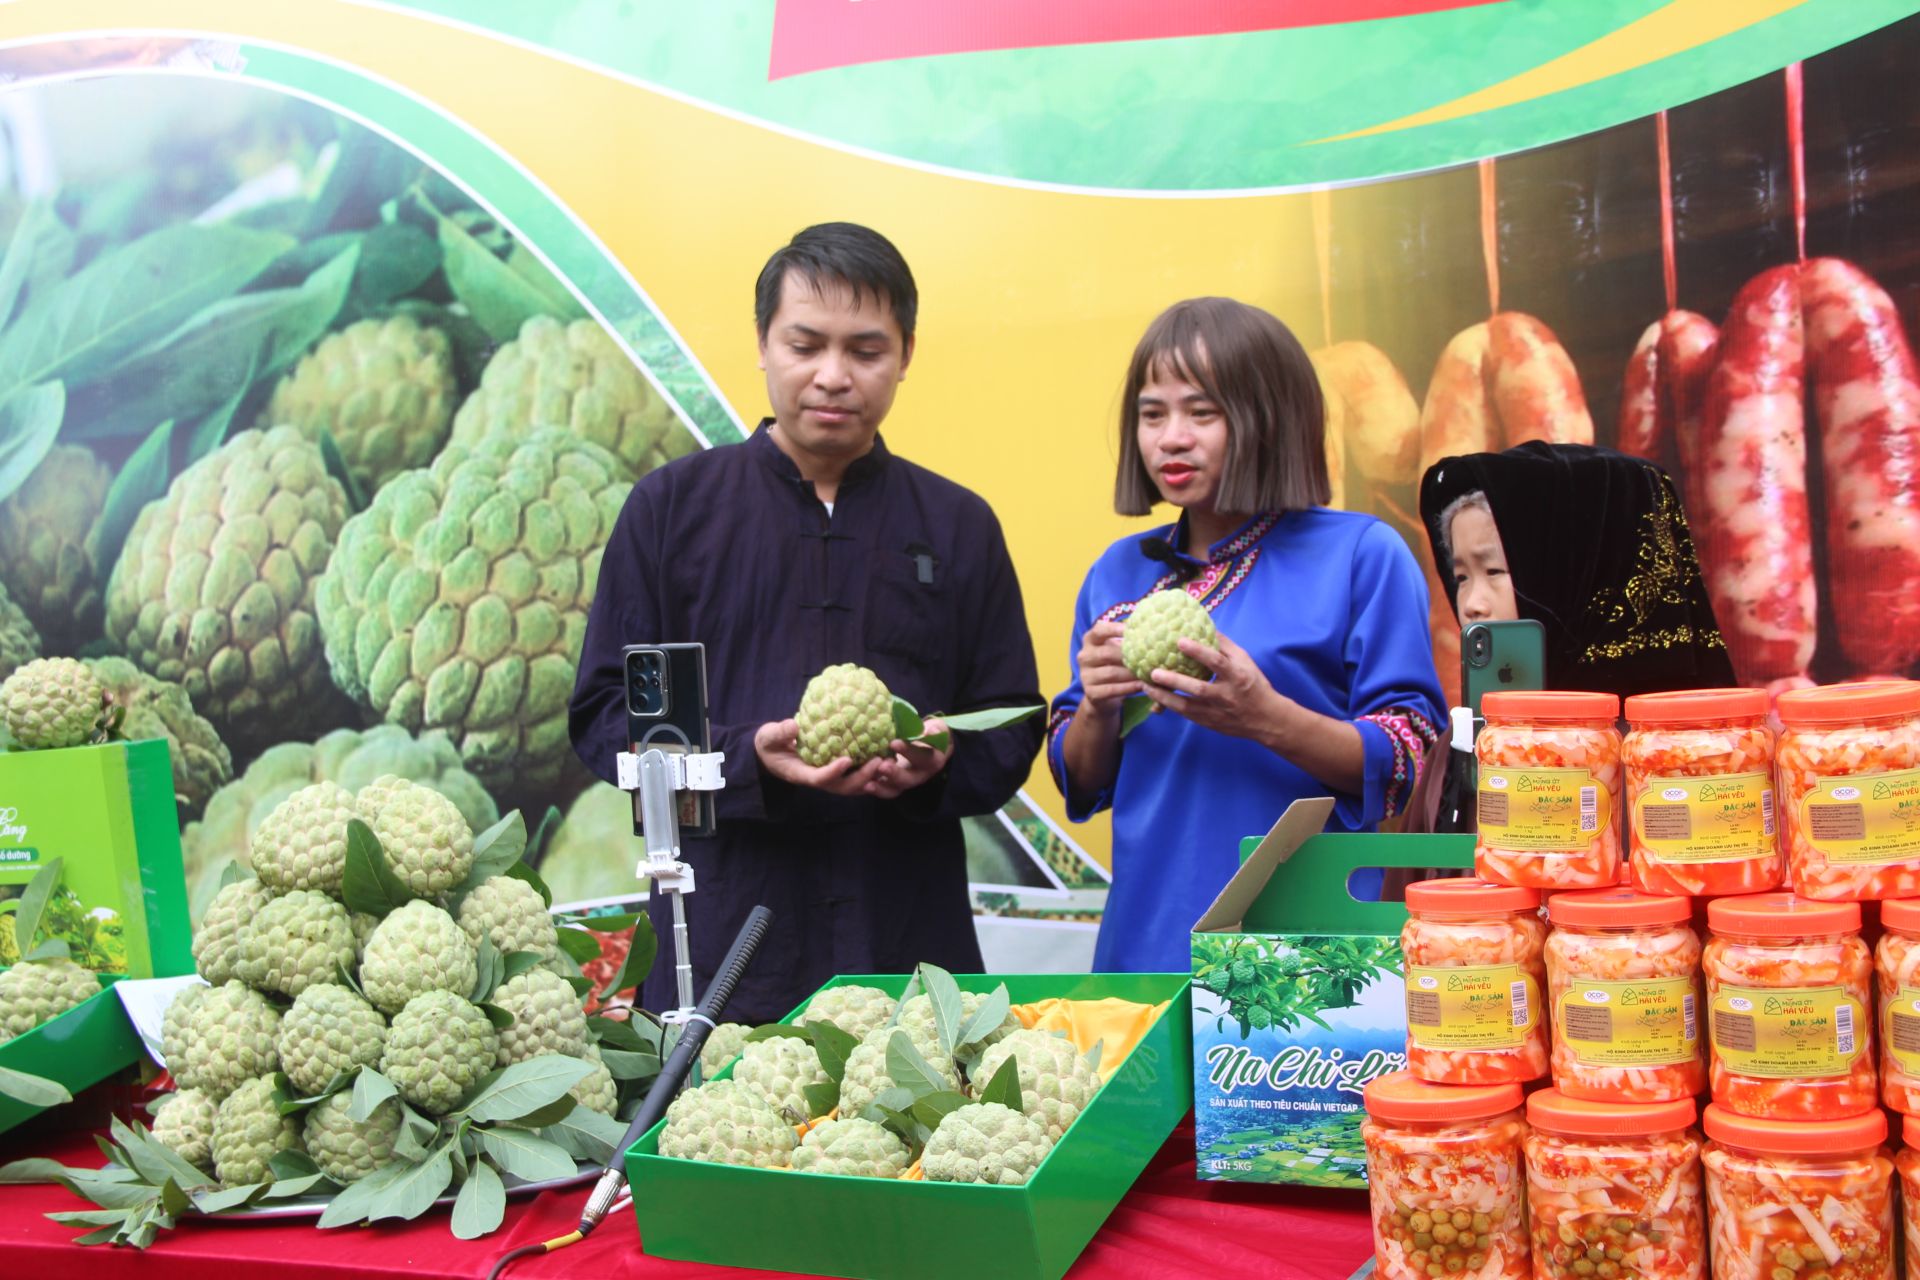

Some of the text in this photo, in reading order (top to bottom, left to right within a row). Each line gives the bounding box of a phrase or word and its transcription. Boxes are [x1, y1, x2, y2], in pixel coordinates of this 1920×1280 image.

[1206, 1044, 1267, 1093] Na
[1267, 1046, 1343, 1091] Chi
[1209, 1095, 1359, 1113] SẢN XUẤT THEO TIÊU CHUẨN VIETGAP
[1211, 1160, 1252, 1171] KLT: 5KG
